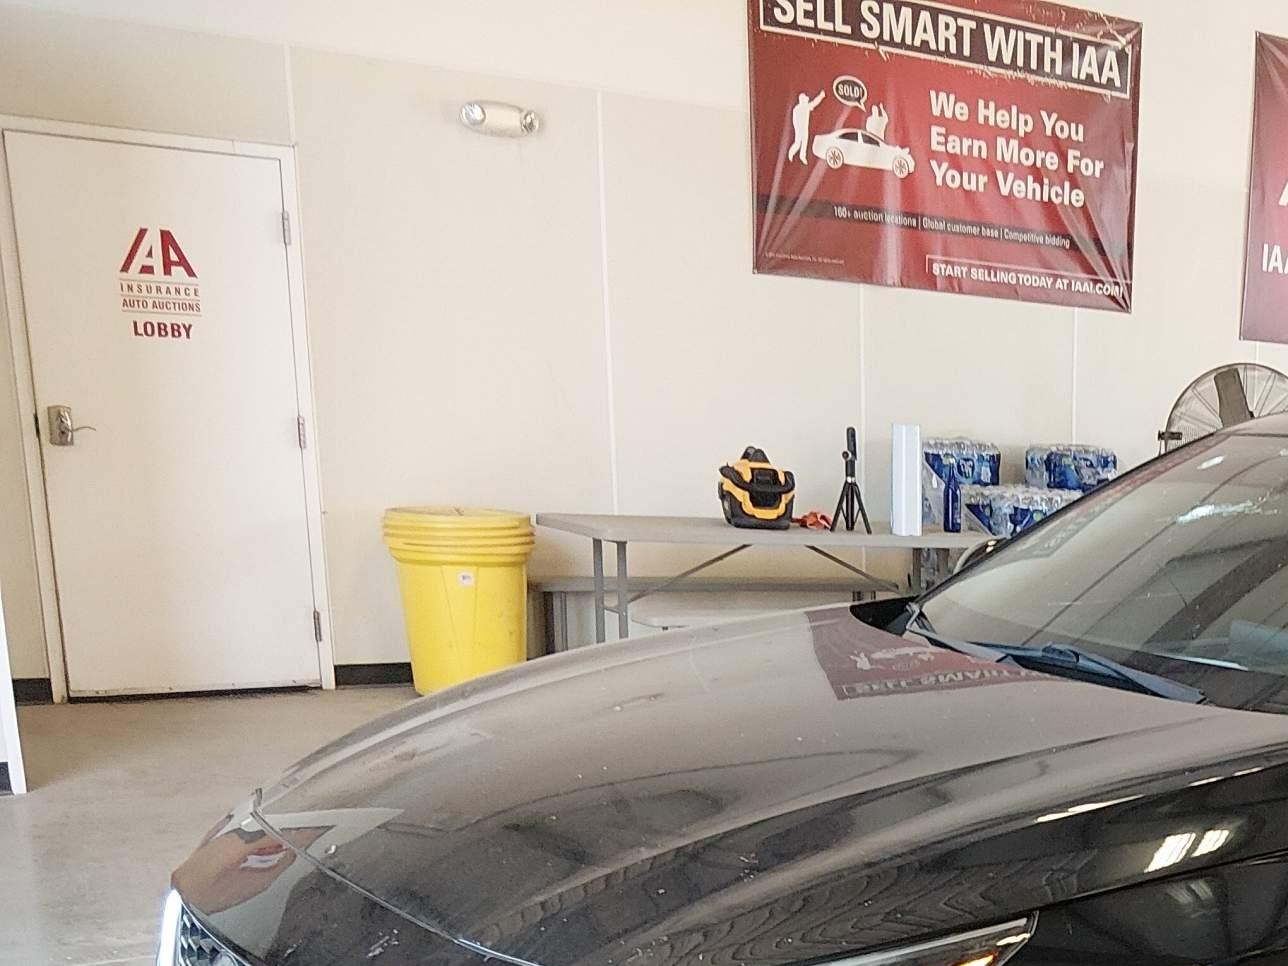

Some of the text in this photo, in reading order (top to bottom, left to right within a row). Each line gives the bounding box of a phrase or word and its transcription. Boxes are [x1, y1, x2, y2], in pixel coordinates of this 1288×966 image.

[773, 0, 1121, 88] SELL SMART WITH IAA
[929, 89, 1084, 142] We Help You
[930, 125, 1104, 178] Earn More For
[929, 159, 1085, 208] Your Vehicle
[853, 210, 884, 222] auction
[922, 217, 946, 229] Global
[947, 221, 980, 235] customer
[981, 225, 999, 238] base
[1004, 228, 1044, 245] Competitive
[1045, 236, 1070, 249] bidding
[120, 283, 200, 297] INSURANCE
[932, 263, 968, 278] START
[970, 268, 1017, 285] SELLING
[1017, 273, 1053, 289] TODAY
[1055, 278, 1069, 291] AT
[122, 298, 201, 312] AUTO AUCTIONS
[133, 320, 192, 339] LOBBY
